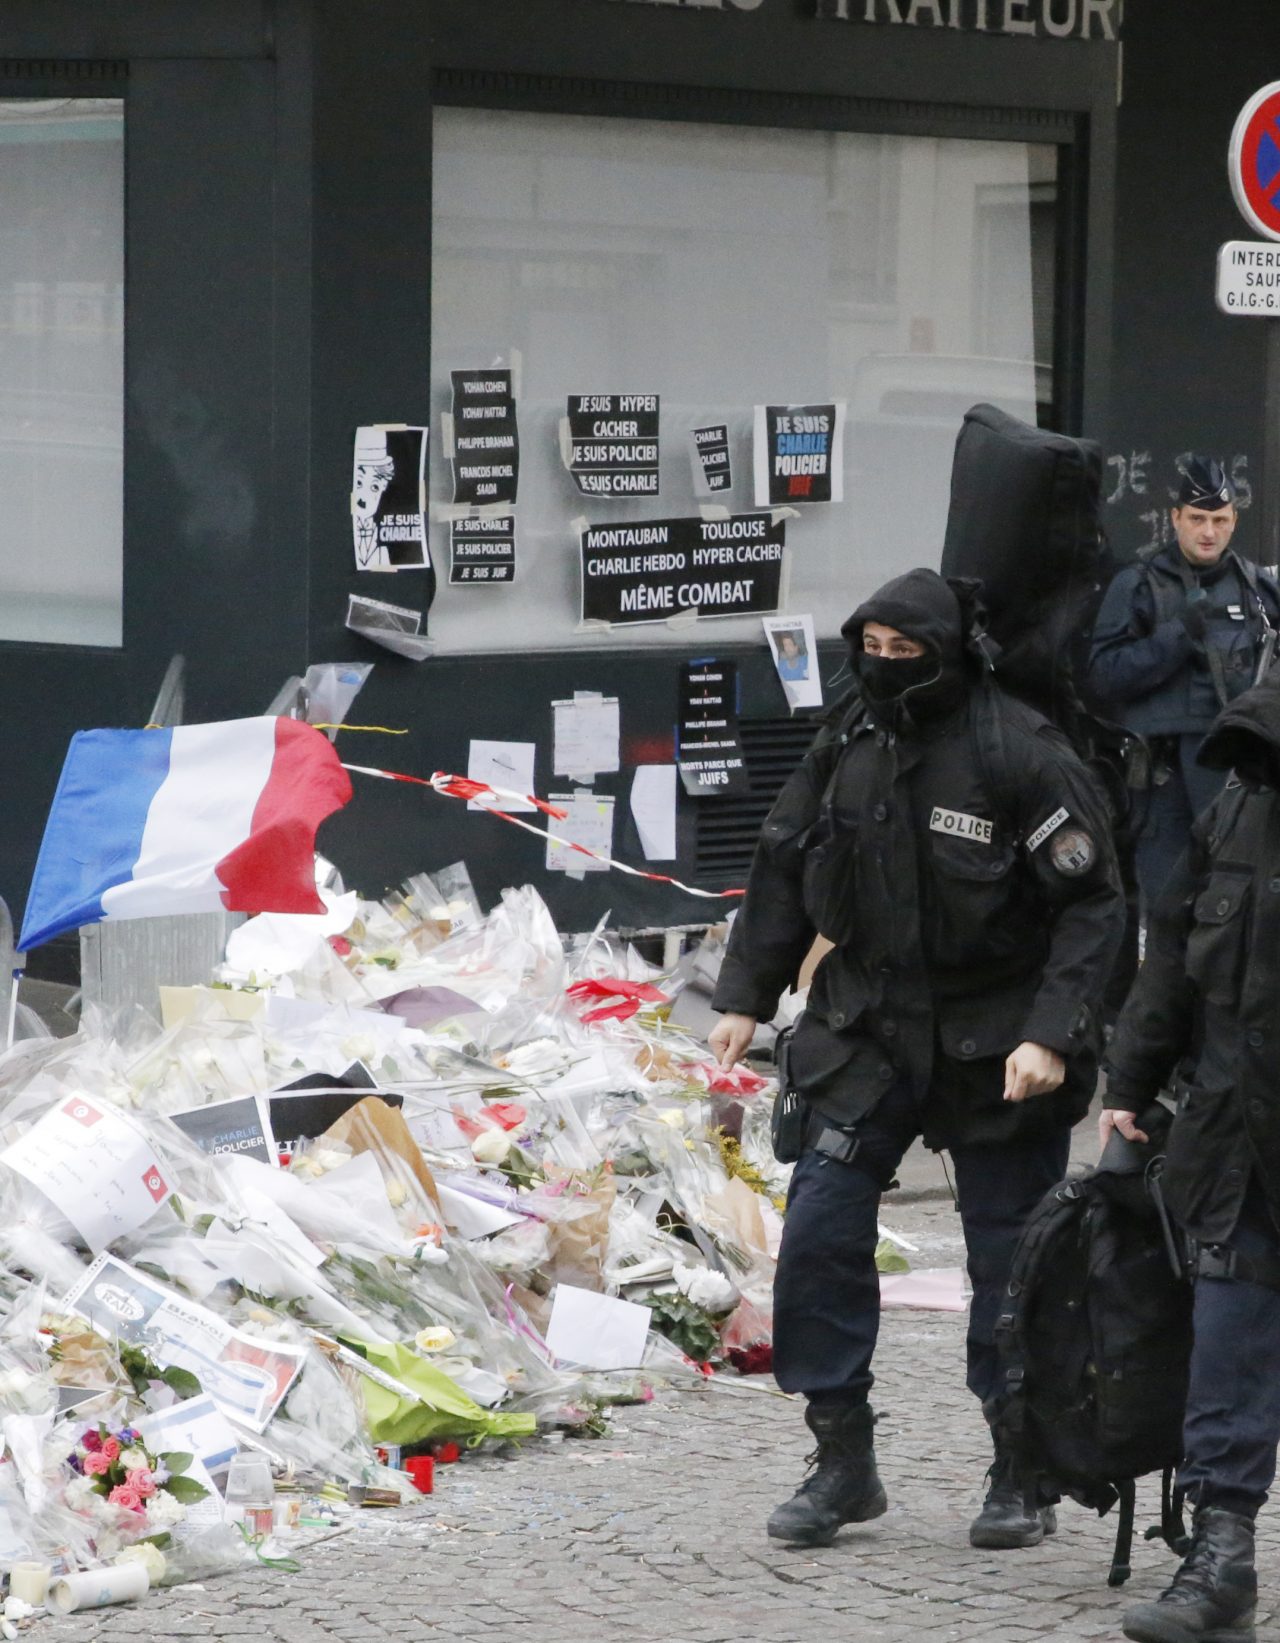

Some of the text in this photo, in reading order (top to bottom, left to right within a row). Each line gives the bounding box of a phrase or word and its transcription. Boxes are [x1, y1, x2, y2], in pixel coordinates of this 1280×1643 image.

[484, 381, 507, 393] COHEN
[578, 396, 656, 413] JE SUIS HYPER
[593, 420, 638, 437] CACHER
[776, 415, 829, 434] JE SUIS
[695, 429, 723, 444] CHARLIE
[777, 434, 828, 455] CHARLIE
[583, 445, 608, 462] SUIS
[609, 445, 658, 462] POLICIER
[702, 452, 727, 466] OLICIER
[775, 455, 827, 476] POLICIER
[589, 475, 611, 492] SUIS
[613, 474, 657, 491] CHARLIE
[1107, 450, 1151, 504] JE
[380, 514, 421, 526] JE SUIS
[455, 520, 509, 532] JE SUIS CHARLIE
[380, 526, 422, 542] CHARLIE
[587, 520, 766, 548] MONTAUBAN TOULOUSE
[456, 543, 512, 555] JE SUIS POLICIER
[587, 544, 782, 576] CHARLIE HEBDO HYPER CACHER
[461, 567, 507, 578] JE SUIS JUIF
[620, 580, 754, 612] MÊME COMBAT
[680, 759, 742, 771] MORTS PARCE QUE
[698, 771, 729, 785] JUIFS
[931, 810, 992, 840] POLICE
[1029, 811, 1065, 848] POLICE
[214, 1126, 258, 1144] CHARLIE
[214, 1135, 265, 1156] POLICIER
[101, 1291, 135, 1316] RAID
[167, 1303, 225, 1339] Bravo!
